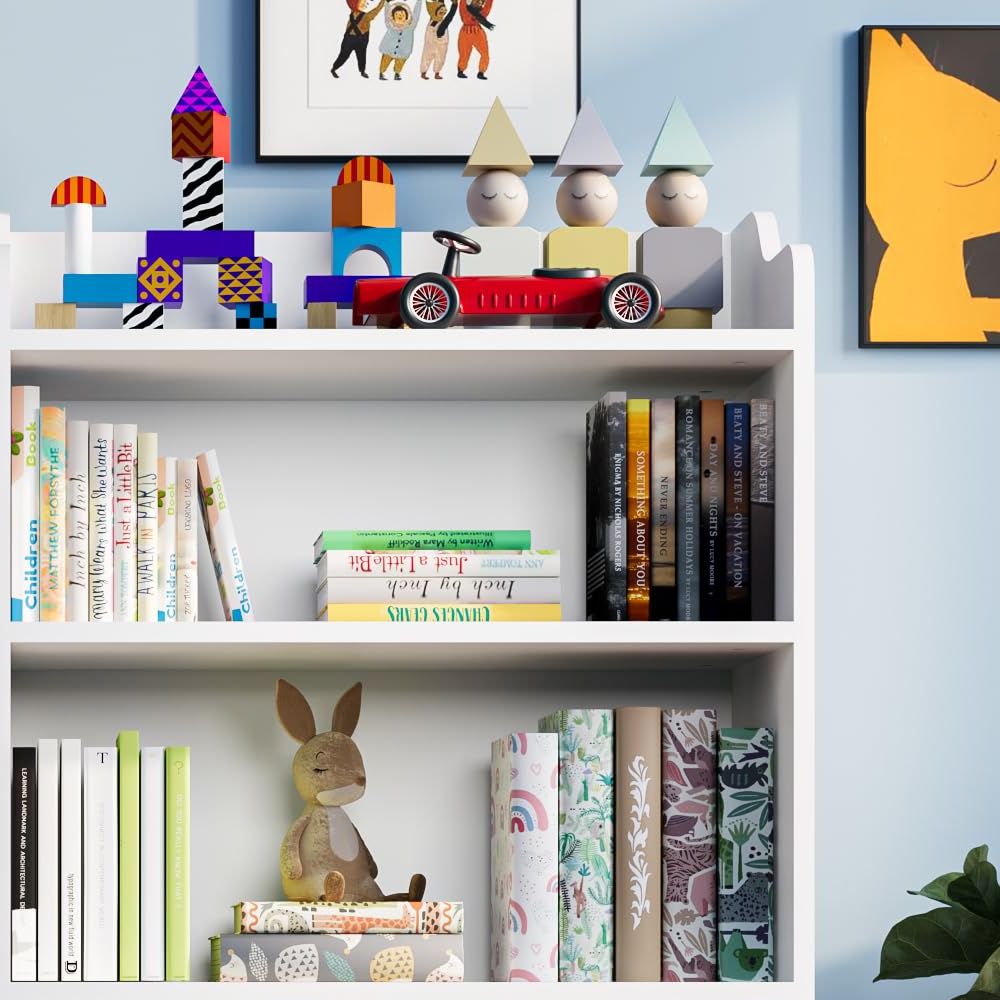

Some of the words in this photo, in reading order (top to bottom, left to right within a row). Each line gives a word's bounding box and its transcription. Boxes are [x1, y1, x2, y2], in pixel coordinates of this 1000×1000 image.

[685, 408, 693, 463] ROMANCE
[734, 408, 742, 440] BEATY
[759, 404, 767, 440] BEATY
[26, 422, 37, 467] Book
[117, 441, 133, 464] Bit
[709, 443, 717, 466] DAY
[734, 444, 742, 467] AND
[759, 443, 767, 467] AND
[50, 447, 59, 517] FORSYTHE
[69, 473, 86, 511] Inch
[116, 465, 132, 503] Little
[137, 473, 157, 519] PARIS
[614, 487, 621, 496] BY
[637, 451, 645, 517] SOMETHING
[660, 476, 668, 510] NEVER
[734, 471, 742, 503] STEVE
[759, 471, 767, 503] STEVE
[685, 482, 693, 523] SUMMER
[709, 497, 717, 537] NIGHTS
[69, 521, 89, 539] by
[115, 519, 132, 549] Just
[139, 529, 153, 540] IN
[660, 514, 668, 556] ENDING
[734, 513, 742, 528] ON
[387, 538, 420, 548] Rockliff
[422, 538, 445, 548] Mara
[448, 538, 457, 548] by
[462, 538, 493, 548] Written
[637, 521, 645, 558] ABOUT
[685, 526, 693, 575] HOLIDAYS
[24, 519, 37, 610] Children
[50, 522, 59, 590] MATTHEW
[69, 551, 86, 588] Inch
[137, 546, 153, 583] WALK
[348, 556, 371, 574] Bit
[373, 556, 415, 574] Little
[419, 556, 428, 566] a
[433, 556, 468, 574] Just
[524, 559, 544, 568] ANN
[734, 533, 742, 588] VACATION
[167, 554, 176, 619] Children
[230, 546, 251, 614] Children
[386, 580, 429, 599] Inch
[440, 577, 460, 598] by
[472, 580, 515, 599] Inch
[637, 563, 645, 587] YOU
[137, 587, 153, 595] A
[97, 752, 108, 764] T
[20, 768, 28, 798] LEARNING
[20, 800, 28, 834] LANDMARK
[65, 960, 77, 974] D
